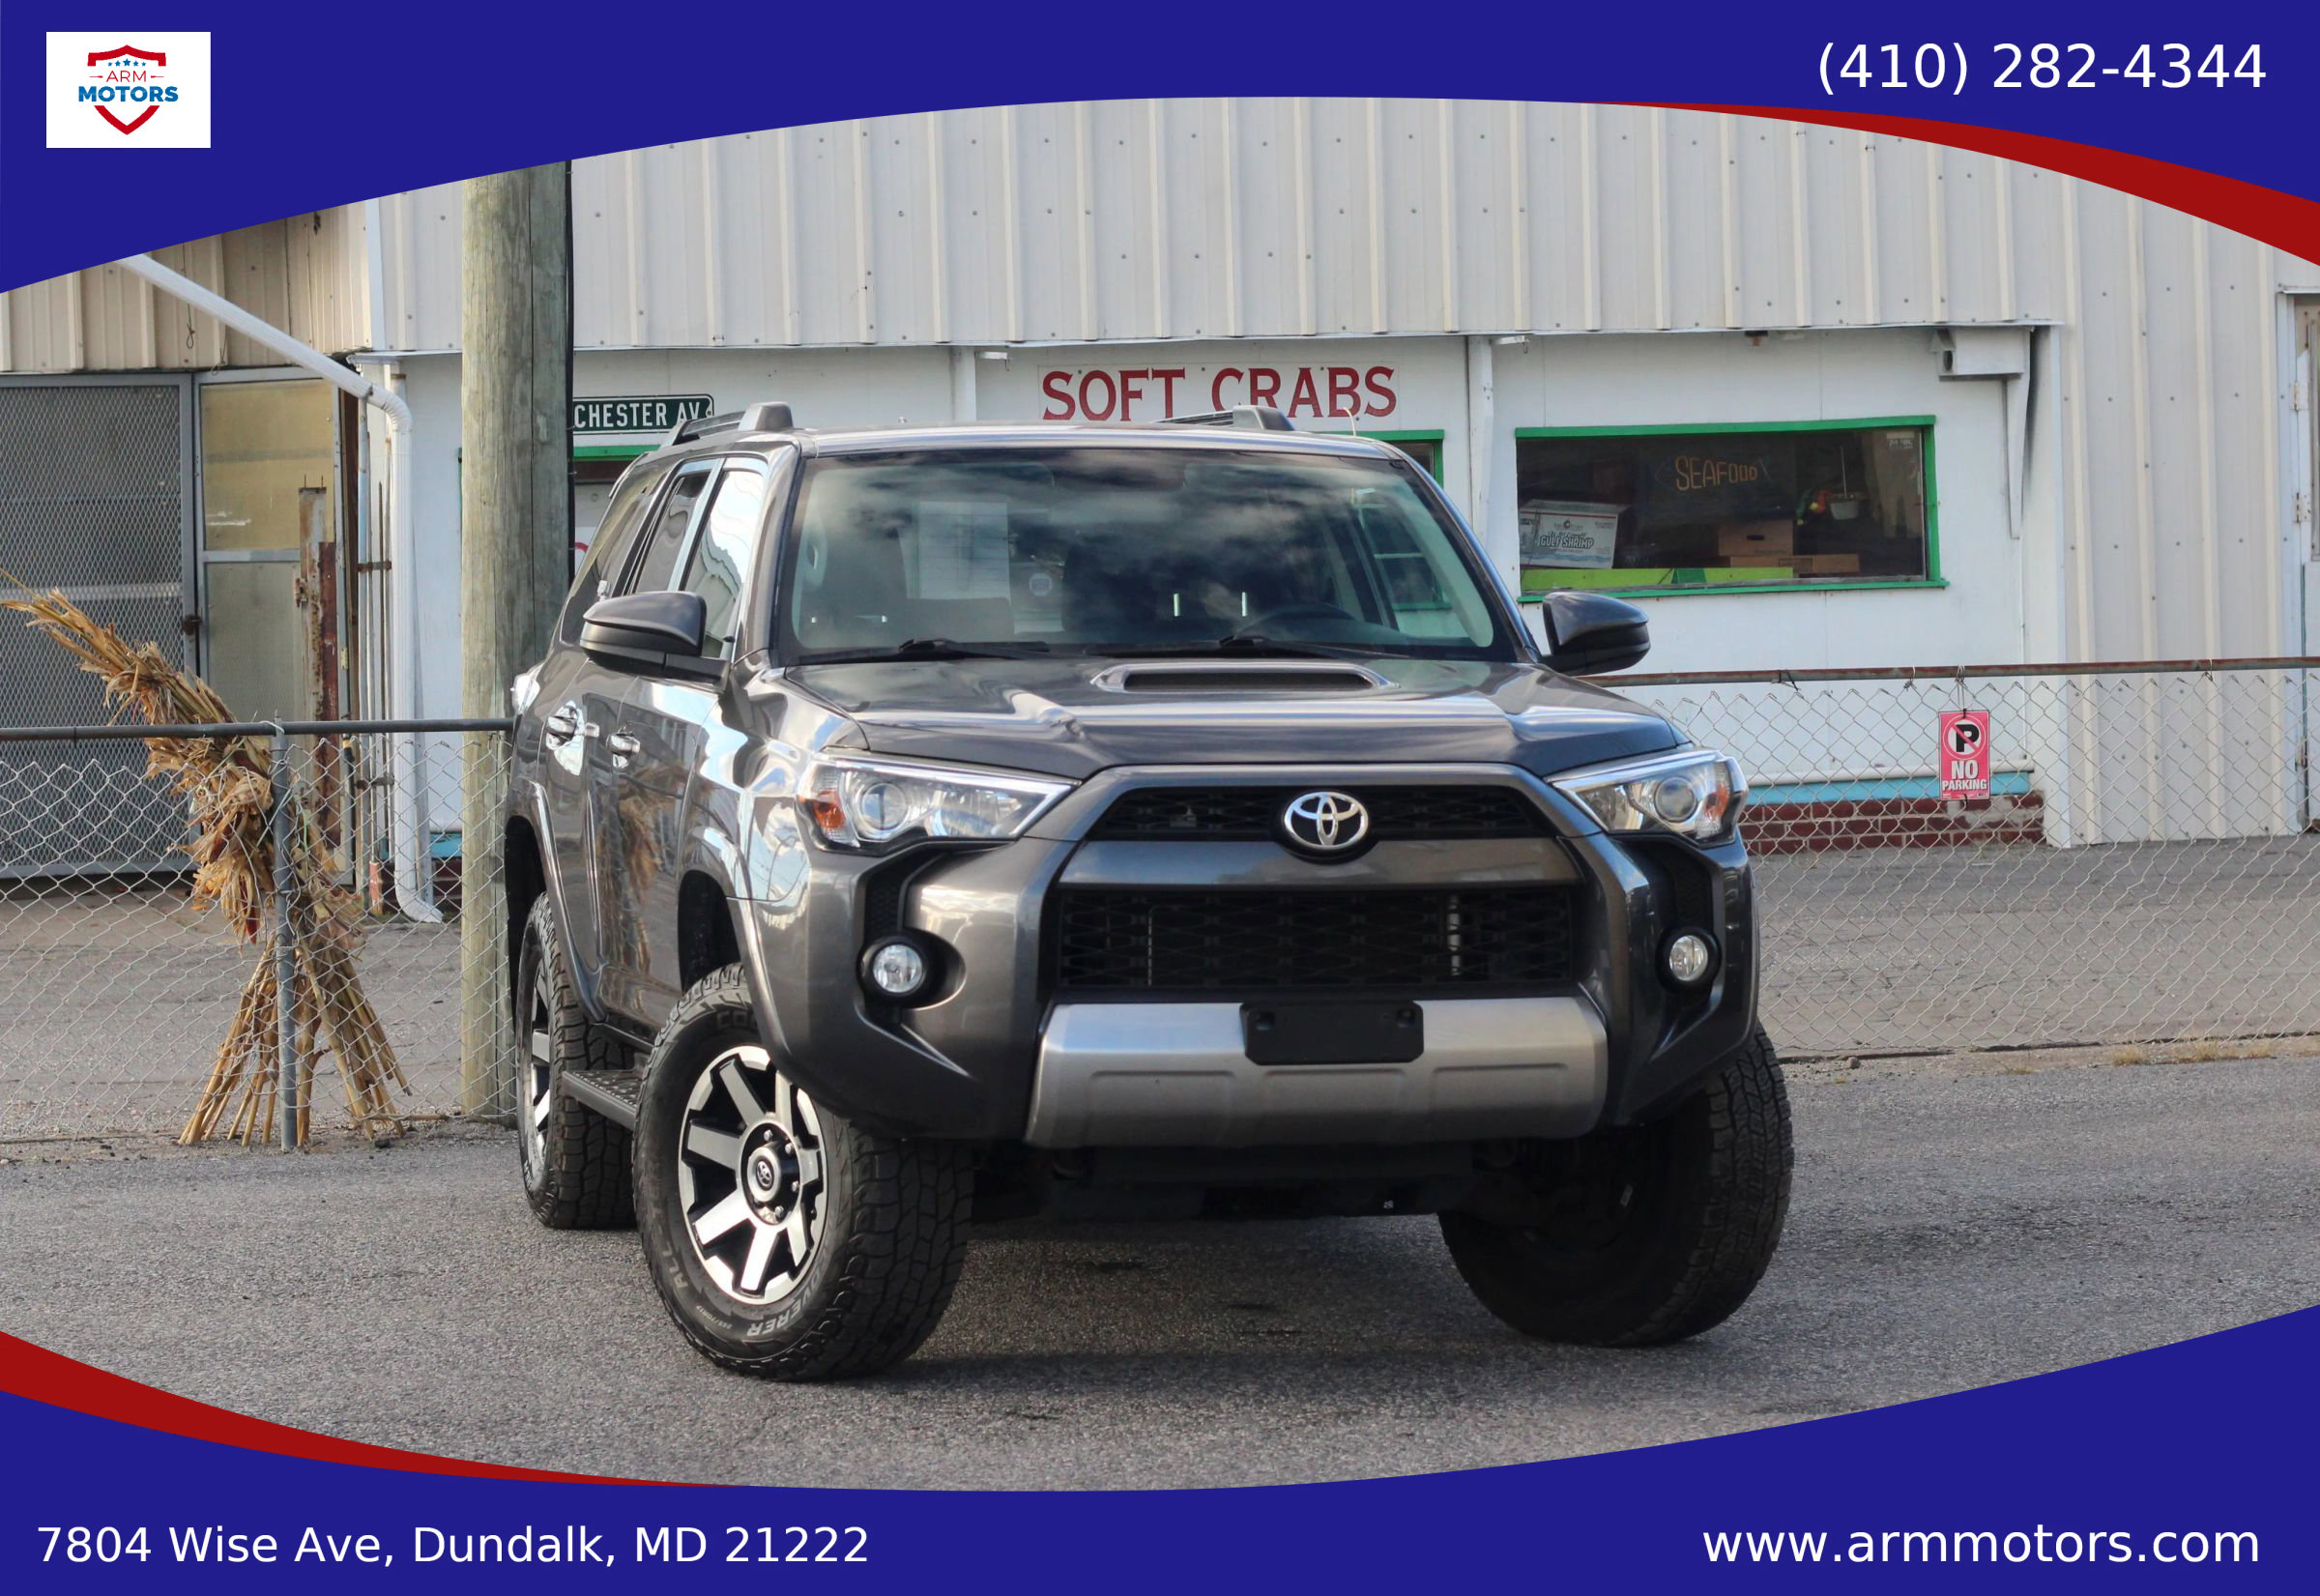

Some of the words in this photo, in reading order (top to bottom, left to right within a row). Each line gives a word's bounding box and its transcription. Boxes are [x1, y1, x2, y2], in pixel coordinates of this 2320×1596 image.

[1042, 367, 1185, 421] SOFT
[1211, 367, 1397, 419] CRABS
[1675, 455, 1757, 491] SEAFOOD
[1540, 535, 1561, 548] GULF
[1561, 537, 1595, 549] SHRIMP
[1951, 759, 1979, 780] NO
[1941, 778, 1987, 791] PARKING
